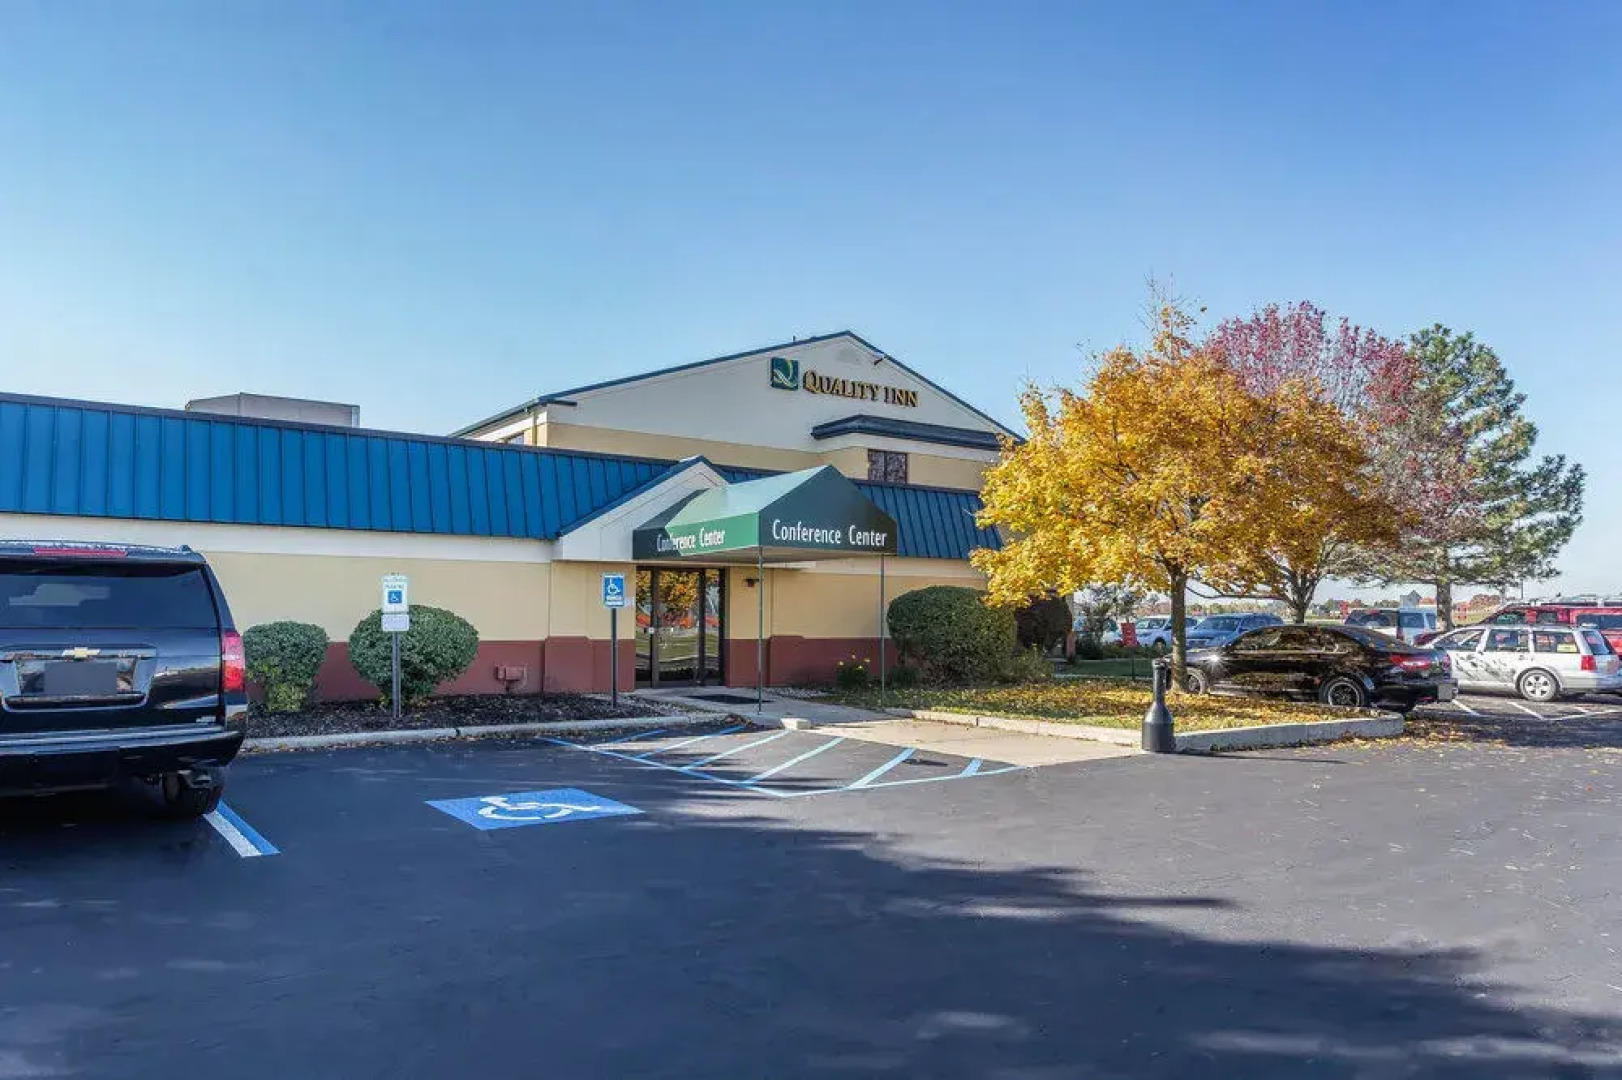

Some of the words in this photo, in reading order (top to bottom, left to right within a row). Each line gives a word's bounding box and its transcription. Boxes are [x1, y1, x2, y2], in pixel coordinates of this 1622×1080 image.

[803, 370, 879, 401] QUALITY
[883, 386, 918, 407] INN
[772, 518, 841, 544] Conference
[848, 524, 887, 546] Center
